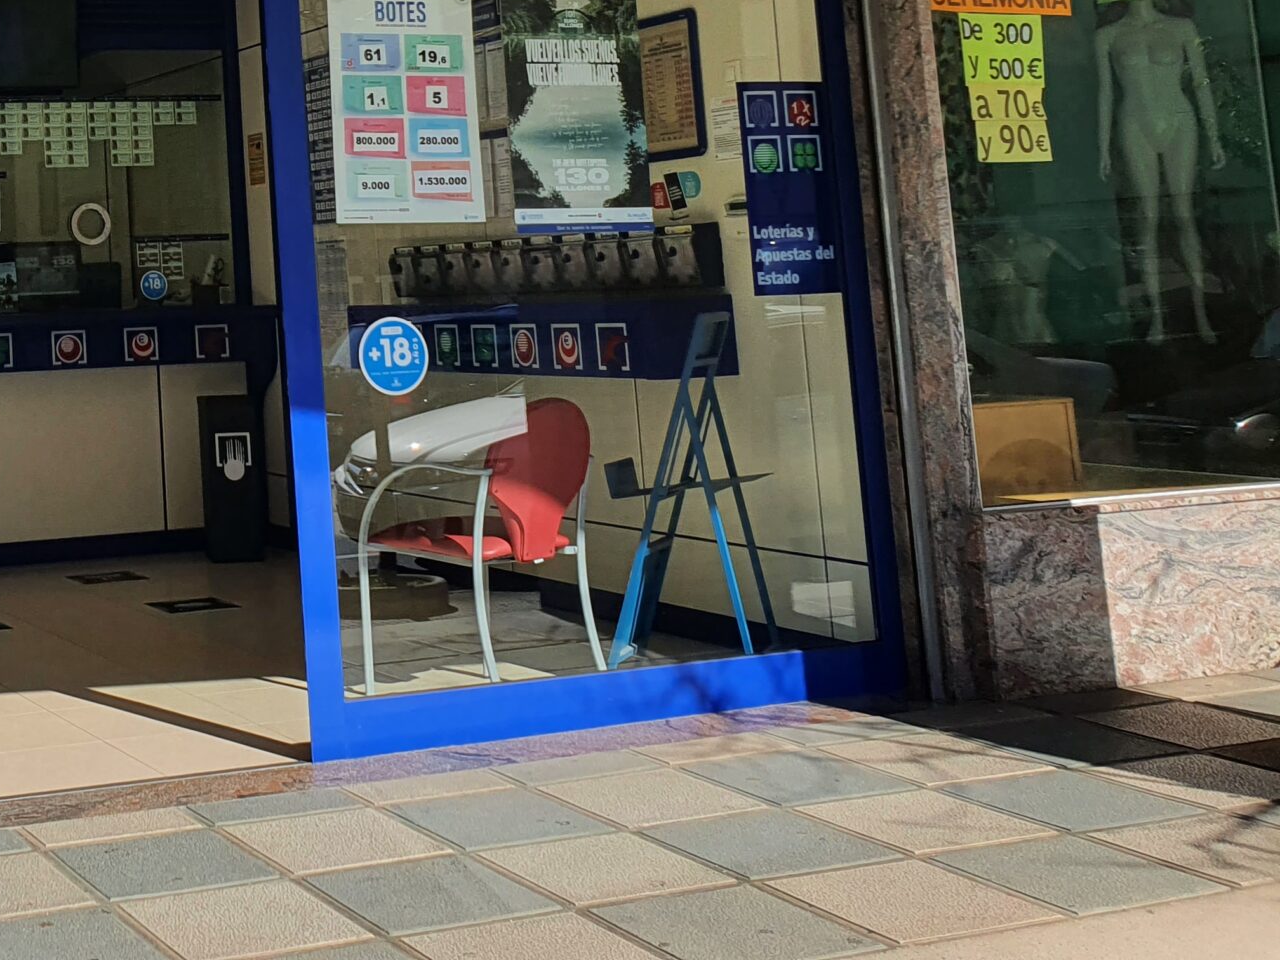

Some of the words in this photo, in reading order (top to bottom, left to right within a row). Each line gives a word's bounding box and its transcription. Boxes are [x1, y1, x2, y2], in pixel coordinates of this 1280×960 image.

[374, 0, 427, 23] BOTES
[961, 18, 983, 41] De
[993, 22, 1033, 44] 300
[363, 48, 382, 62] 61
[418, 50, 447, 65] 19,6
[968, 55, 979, 79] y
[366, 92, 386, 107] 1,1
[432, 92, 442, 104] 5
[975, 95, 993, 119] a
[356, 136, 396, 146] 800.000
[419, 136, 459, 146] 280.000
[979, 136, 992, 161] y
[418, 177, 467, 186] 1.530.000
[553, 168, 610, 184] 130
[362, 181, 390, 190] 9.000
[753, 224, 804, 239] Loterías
[807, 225, 815, 241] y
[755, 247, 812, 265] Apuestas
[815, 245, 835, 260] del
[757, 271, 800, 285] Estado
